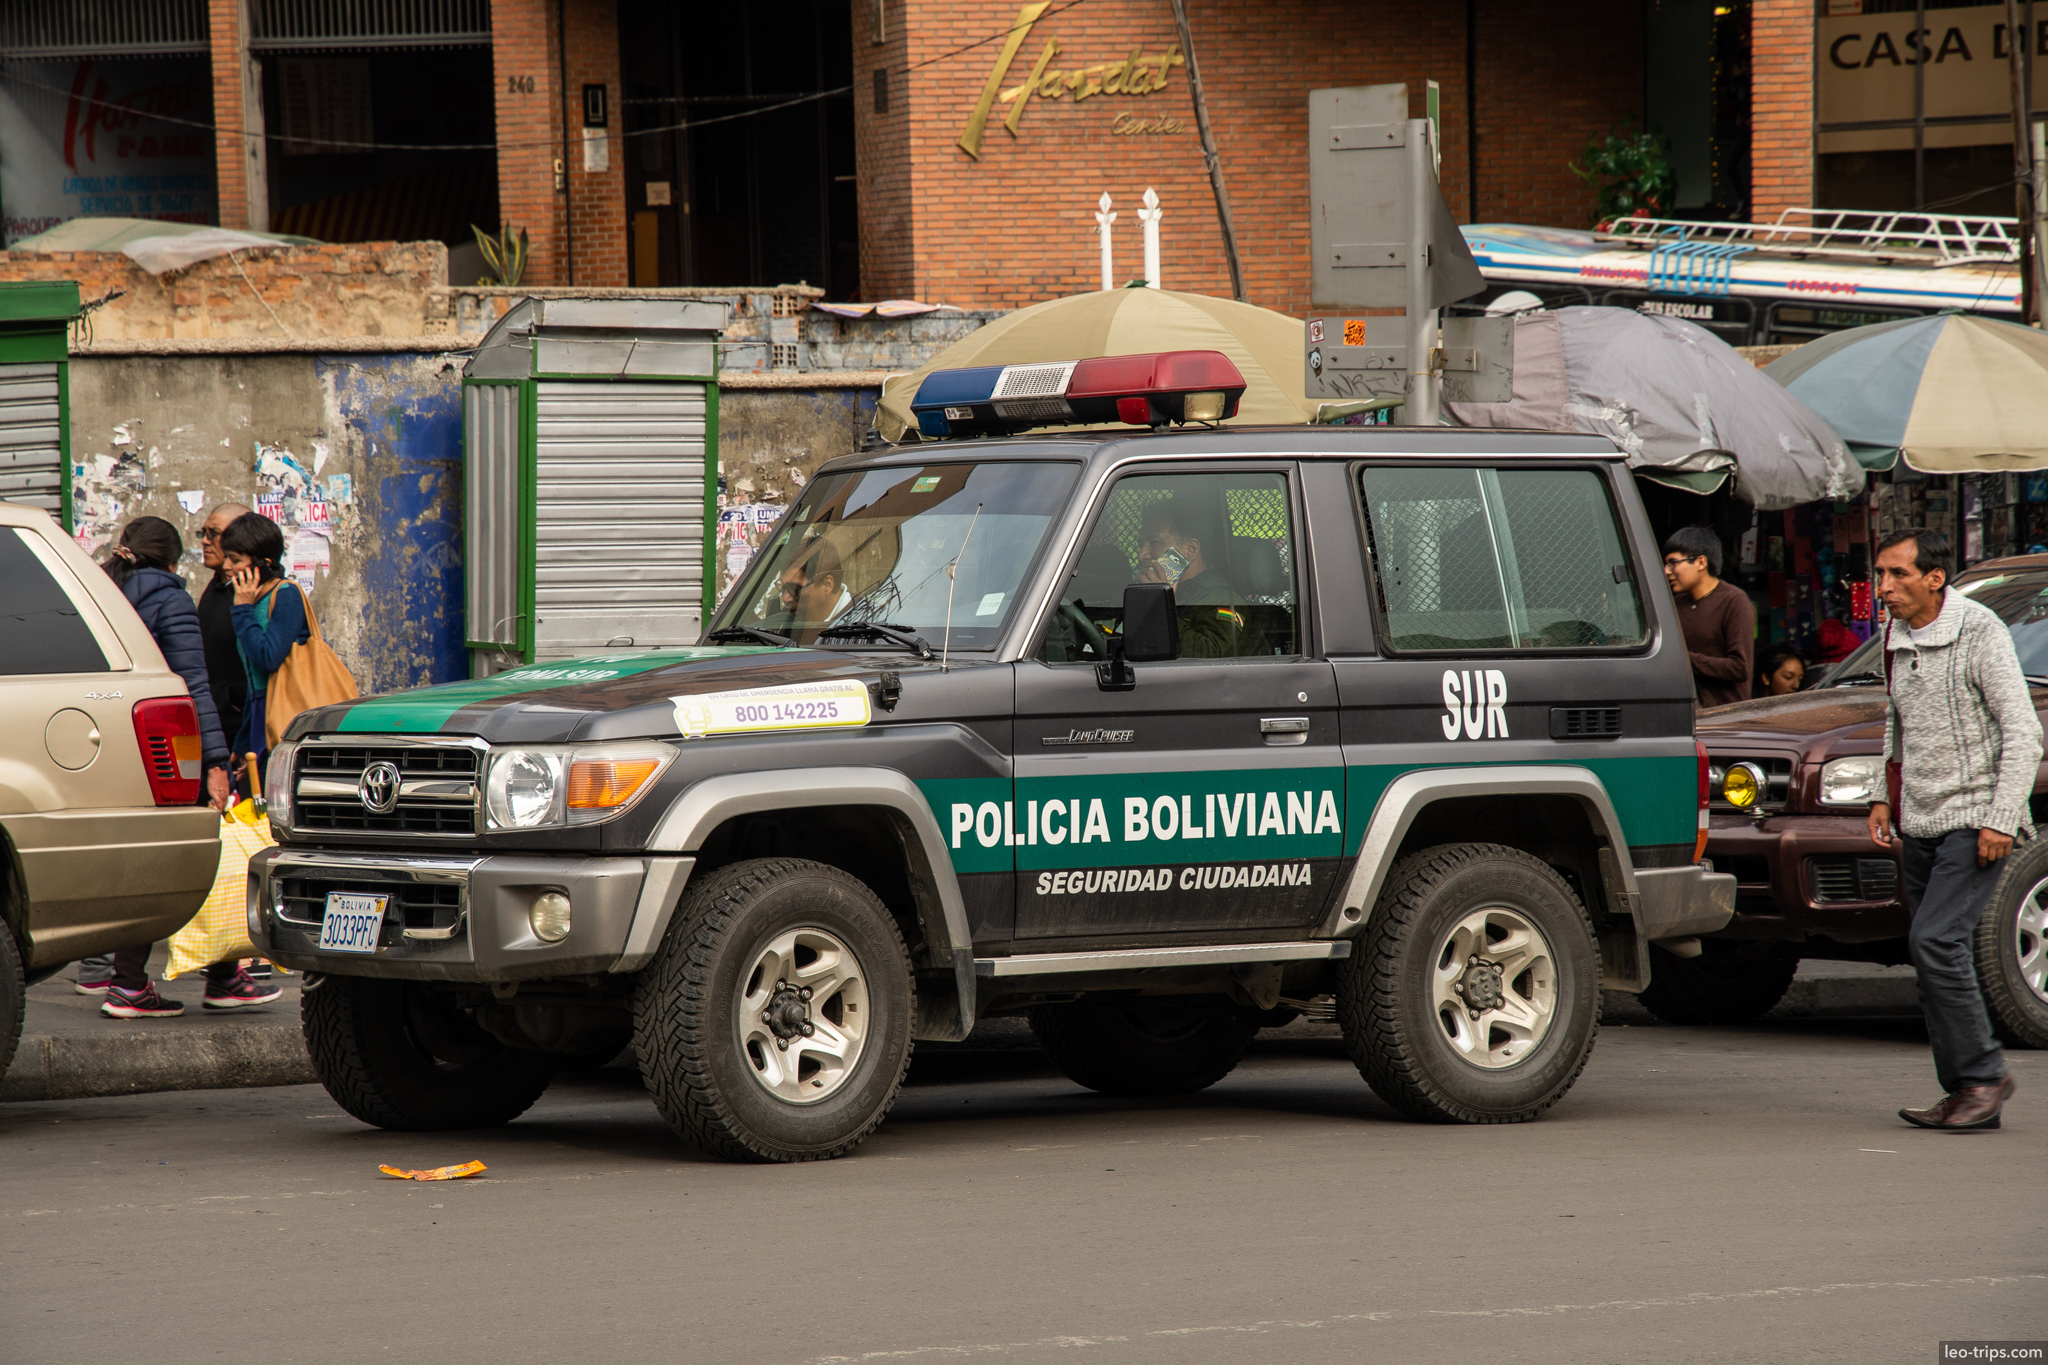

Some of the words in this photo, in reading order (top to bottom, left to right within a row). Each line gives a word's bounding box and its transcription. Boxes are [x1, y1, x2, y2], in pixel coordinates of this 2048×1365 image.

[1829, 27, 1973, 69] CASA
[508, 75, 535, 94] 240
[1112, 111, 1185, 136] Center
[117, 135, 206, 158] PARK
[138, 195, 153, 212] DE
[1664, 302, 1714, 319] ESCOLAR
[750, 688, 795, 697] EMERGENCIA
[796, 686, 819, 694] LLAMA
[820, 684, 844, 693] GRATIS
[844, 684, 855, 692] AL
[735, 704, 769, 723] 800
[773, 701, 838, 721] 142225
[1441, 669, 1509, 741] SUR
[951, 798, 1111, 849] POLICIA
[1124, 790, 1341, 842] BOLIVIANA
[1036, 868, 1173, 896] SEGURIDAD
[1179, 864, 1312, 890] CIUDADANA
[341, 900, 371, 912] BOLIVIA
[324, 913, 379, 947] 3033PFC
